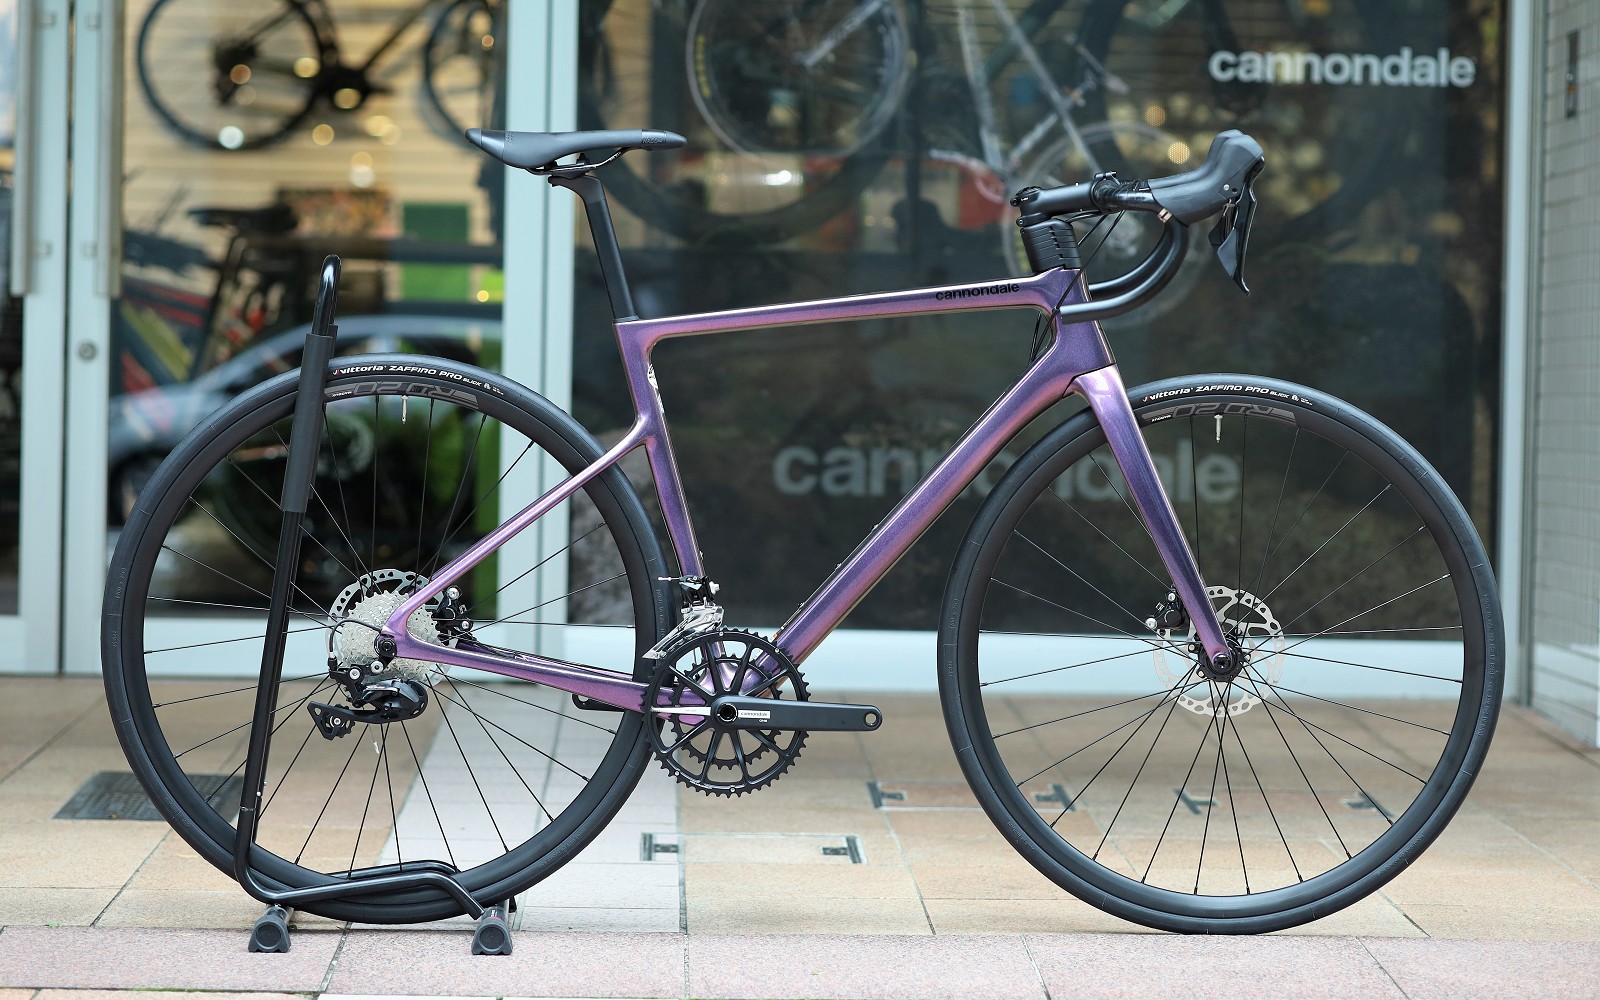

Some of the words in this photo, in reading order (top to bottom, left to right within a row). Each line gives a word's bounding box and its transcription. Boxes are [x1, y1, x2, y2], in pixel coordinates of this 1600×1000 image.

[1208, 46, 1476, 87] cannondale
[935, 283, 1020, 301] cannondale
[388, 365, 437, 375] ZAFFIRO
[439, 370, 463, 380] PRO
[1195, 384, 1243, 393] ZAFFIRO
[1244, 385, 1270, 395] PRO
[773, 438, 1241, 505] canole
